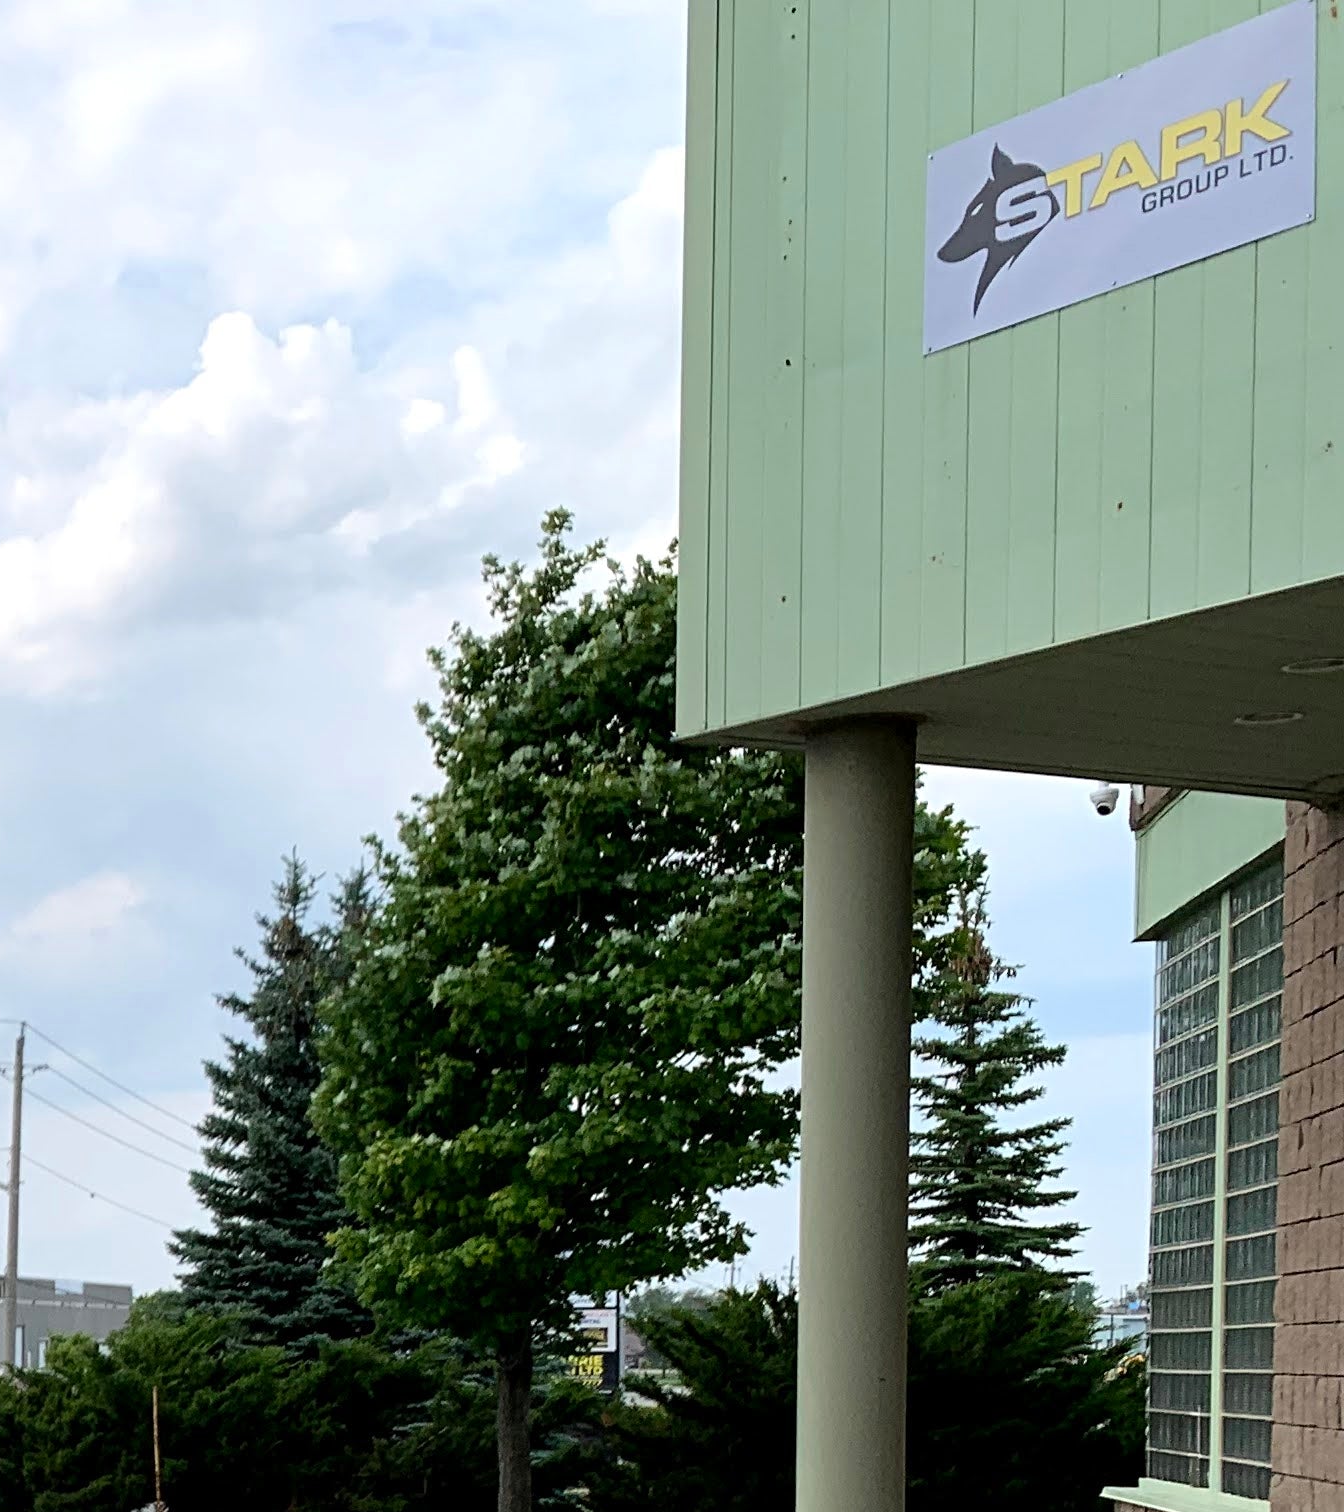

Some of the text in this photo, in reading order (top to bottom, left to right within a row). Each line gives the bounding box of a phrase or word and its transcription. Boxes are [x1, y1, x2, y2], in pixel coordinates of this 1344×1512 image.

[995, 78, 1292, 242] STARK
[1141, 143, 1295, 213] GROUP LTD.
